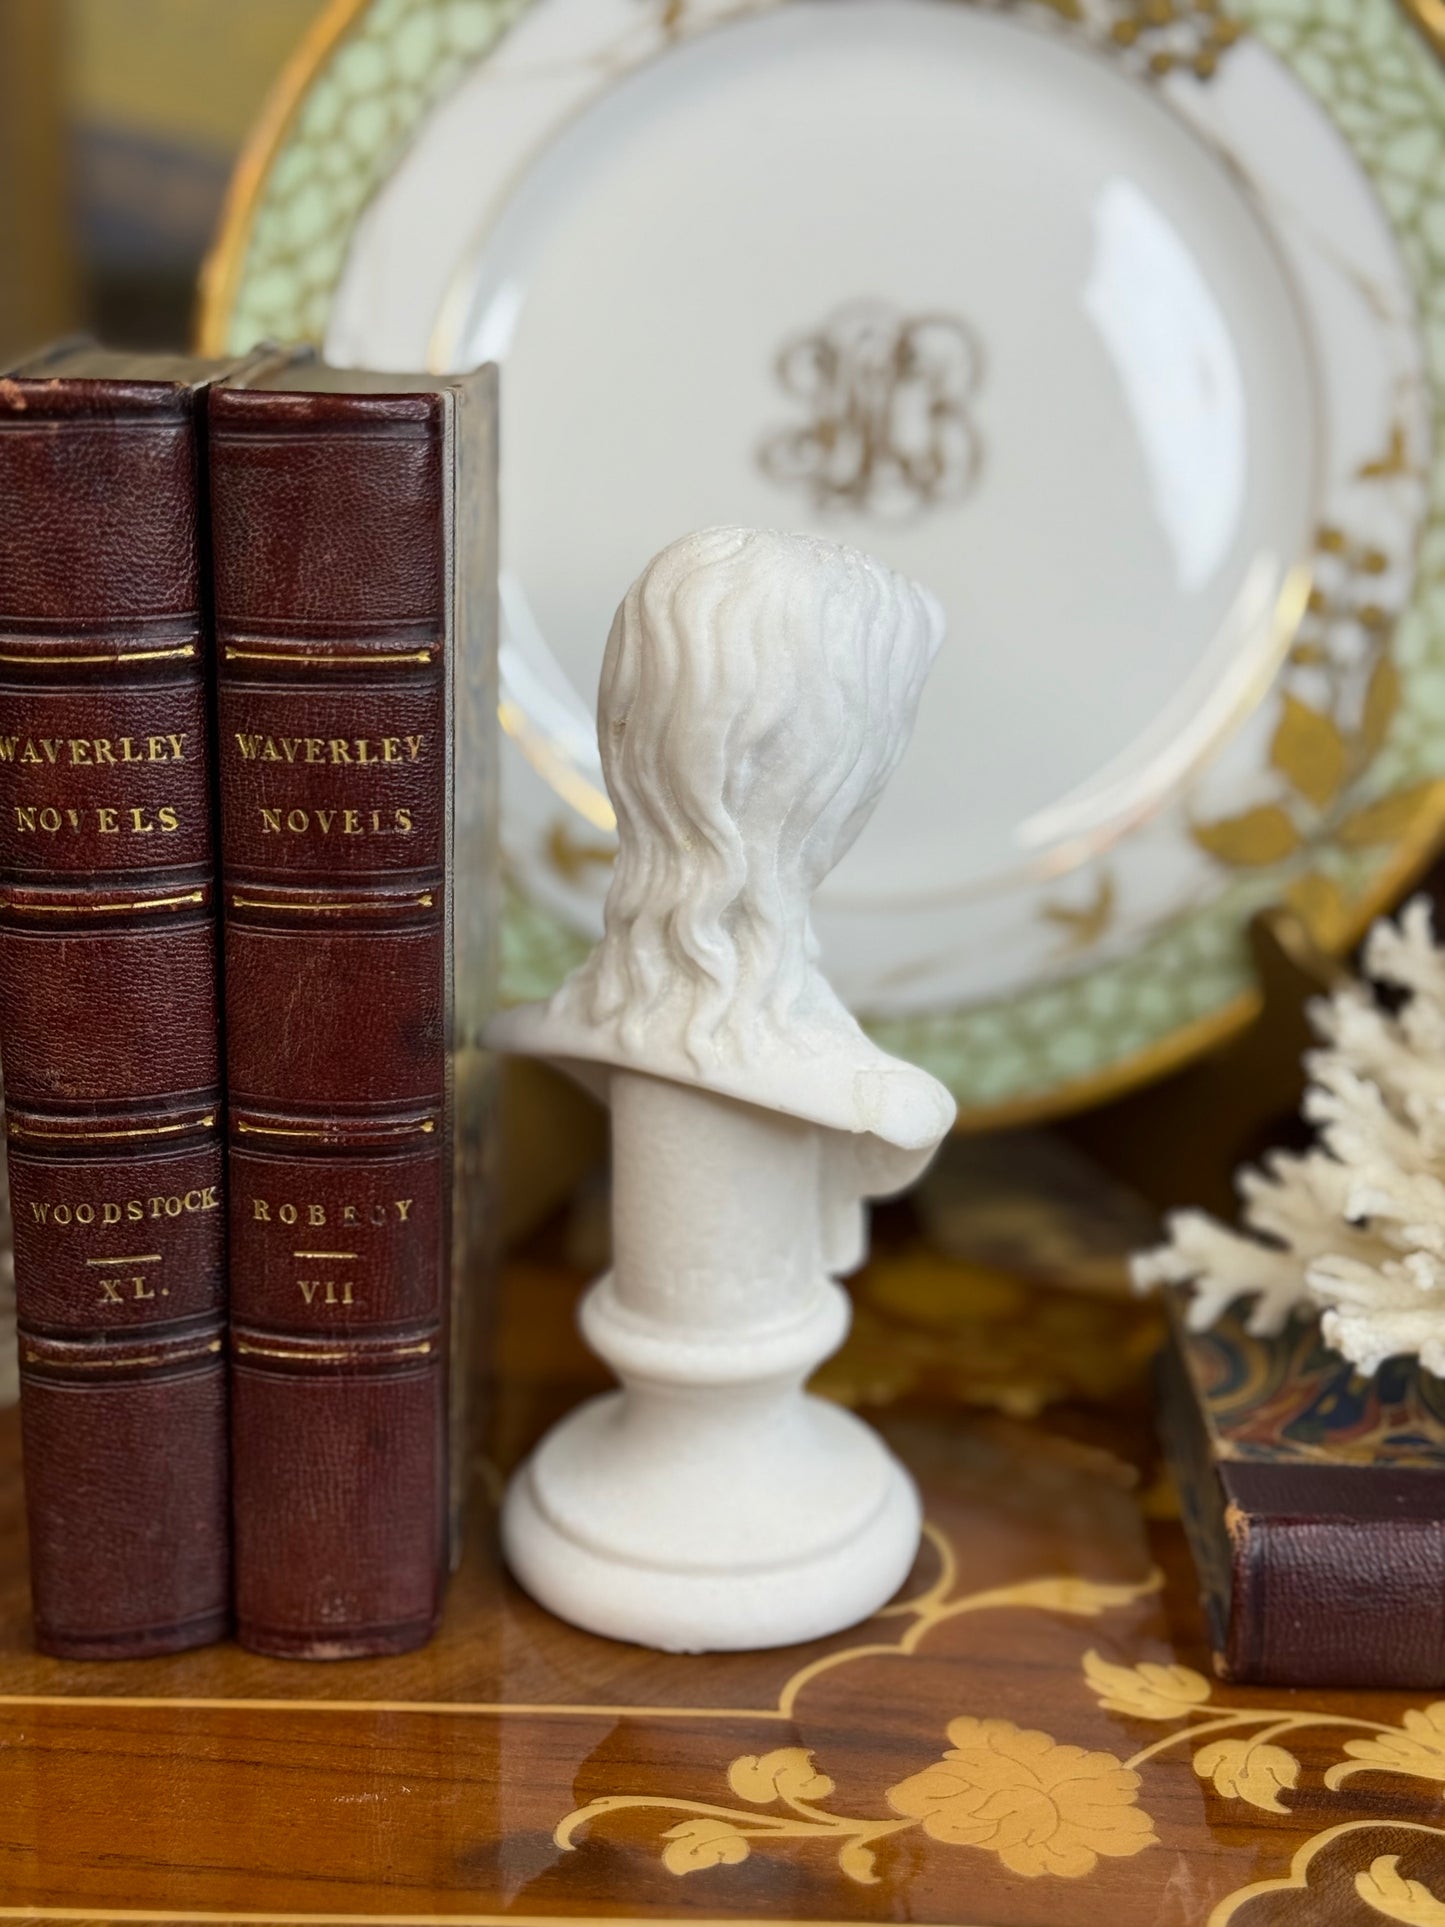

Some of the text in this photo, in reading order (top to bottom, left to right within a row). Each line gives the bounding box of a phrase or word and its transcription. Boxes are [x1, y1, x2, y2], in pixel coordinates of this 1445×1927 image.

[0, 733, 187, 765] WAVERLEY
[235, 733, 424, 764] WAVERLEY
[14, 806, 180, 834] NOVELS
[261, 808, 414, 834] NOVELS
[30, 1186, 220, 1225] WOODSTOCK
[253, 1199, 327, 1226] ROB
[100, 1276, 170, 1303] XL.
[297, 1281, 354, 1304] VII
